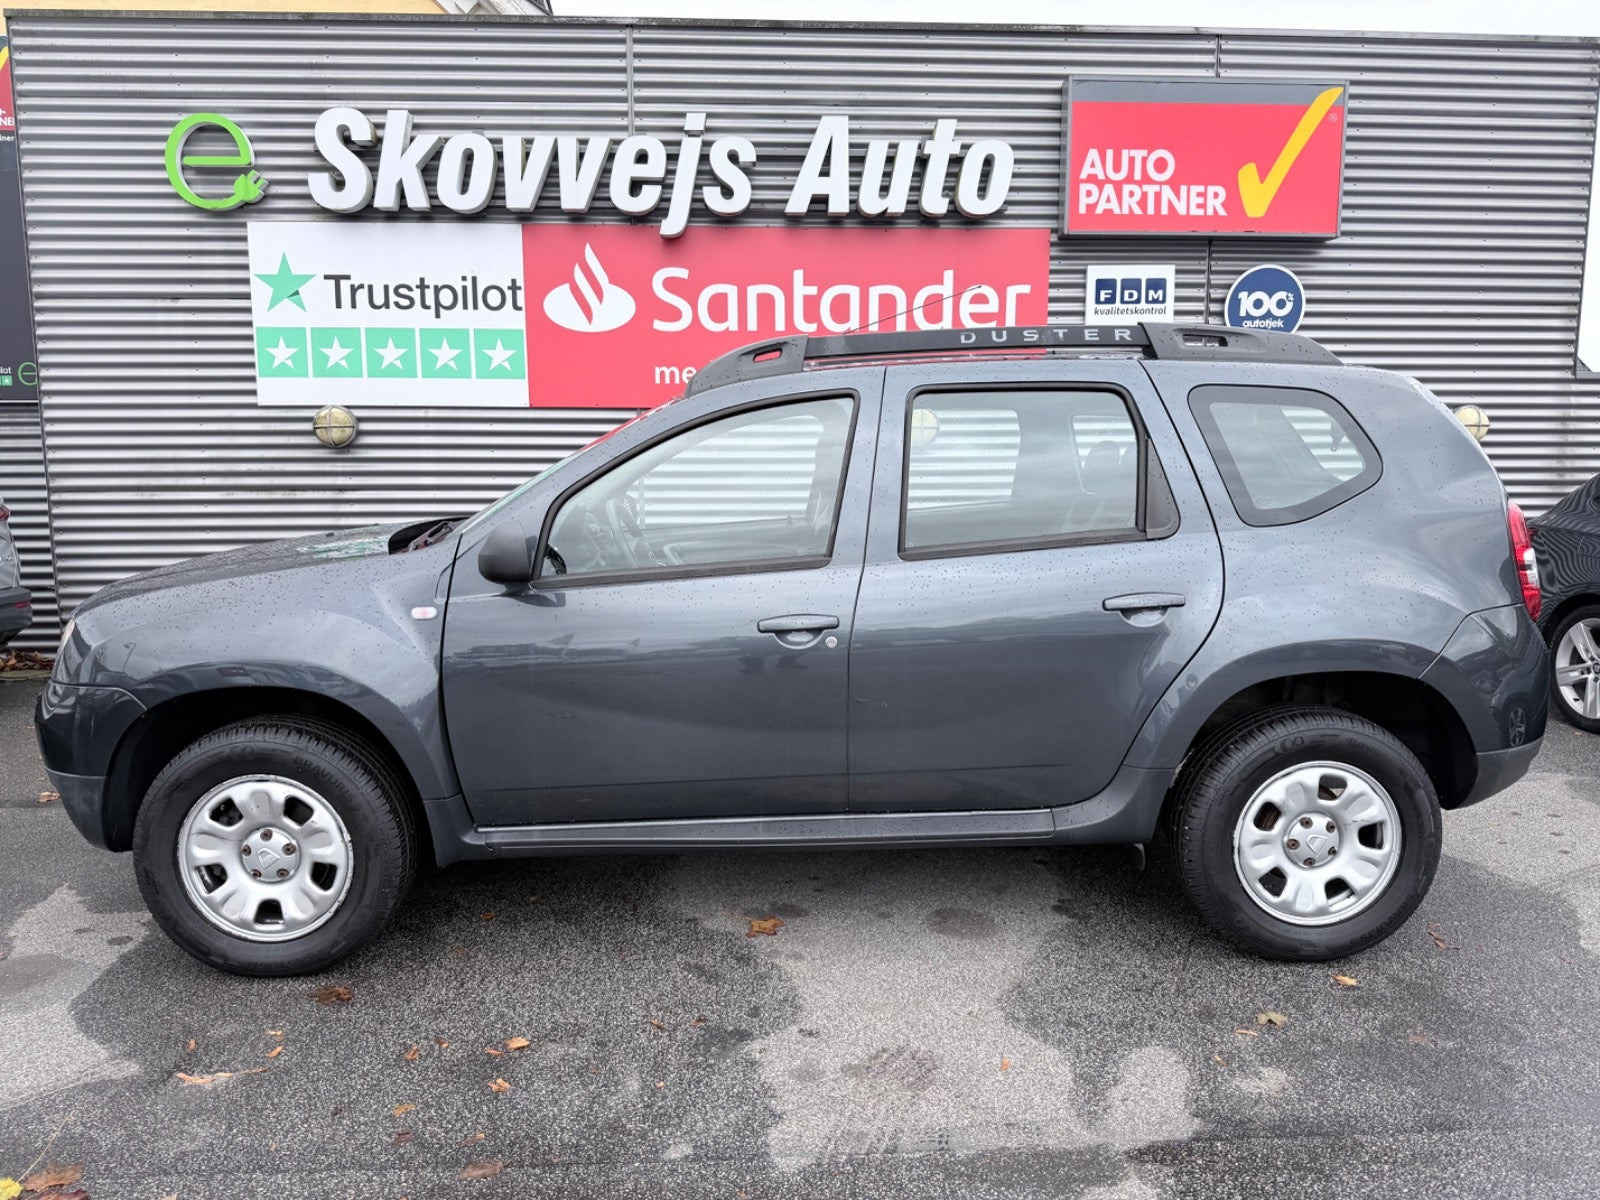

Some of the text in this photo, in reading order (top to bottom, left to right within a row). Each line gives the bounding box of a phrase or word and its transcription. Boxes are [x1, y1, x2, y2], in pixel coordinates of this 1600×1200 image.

[308, 106, 1015, 239] Skovvejs Auto
[1079, 148, 1176, 182] AUTO
[1078, 184, 1228, 217] PARTNER
[323, 274, 524, 319] Trustpilot
[652, 267, 1031, 333] Santander
[1094, 306, 1167, 316] kvalitetskontrol
[960, 328, 1133, 345] DUSTER
